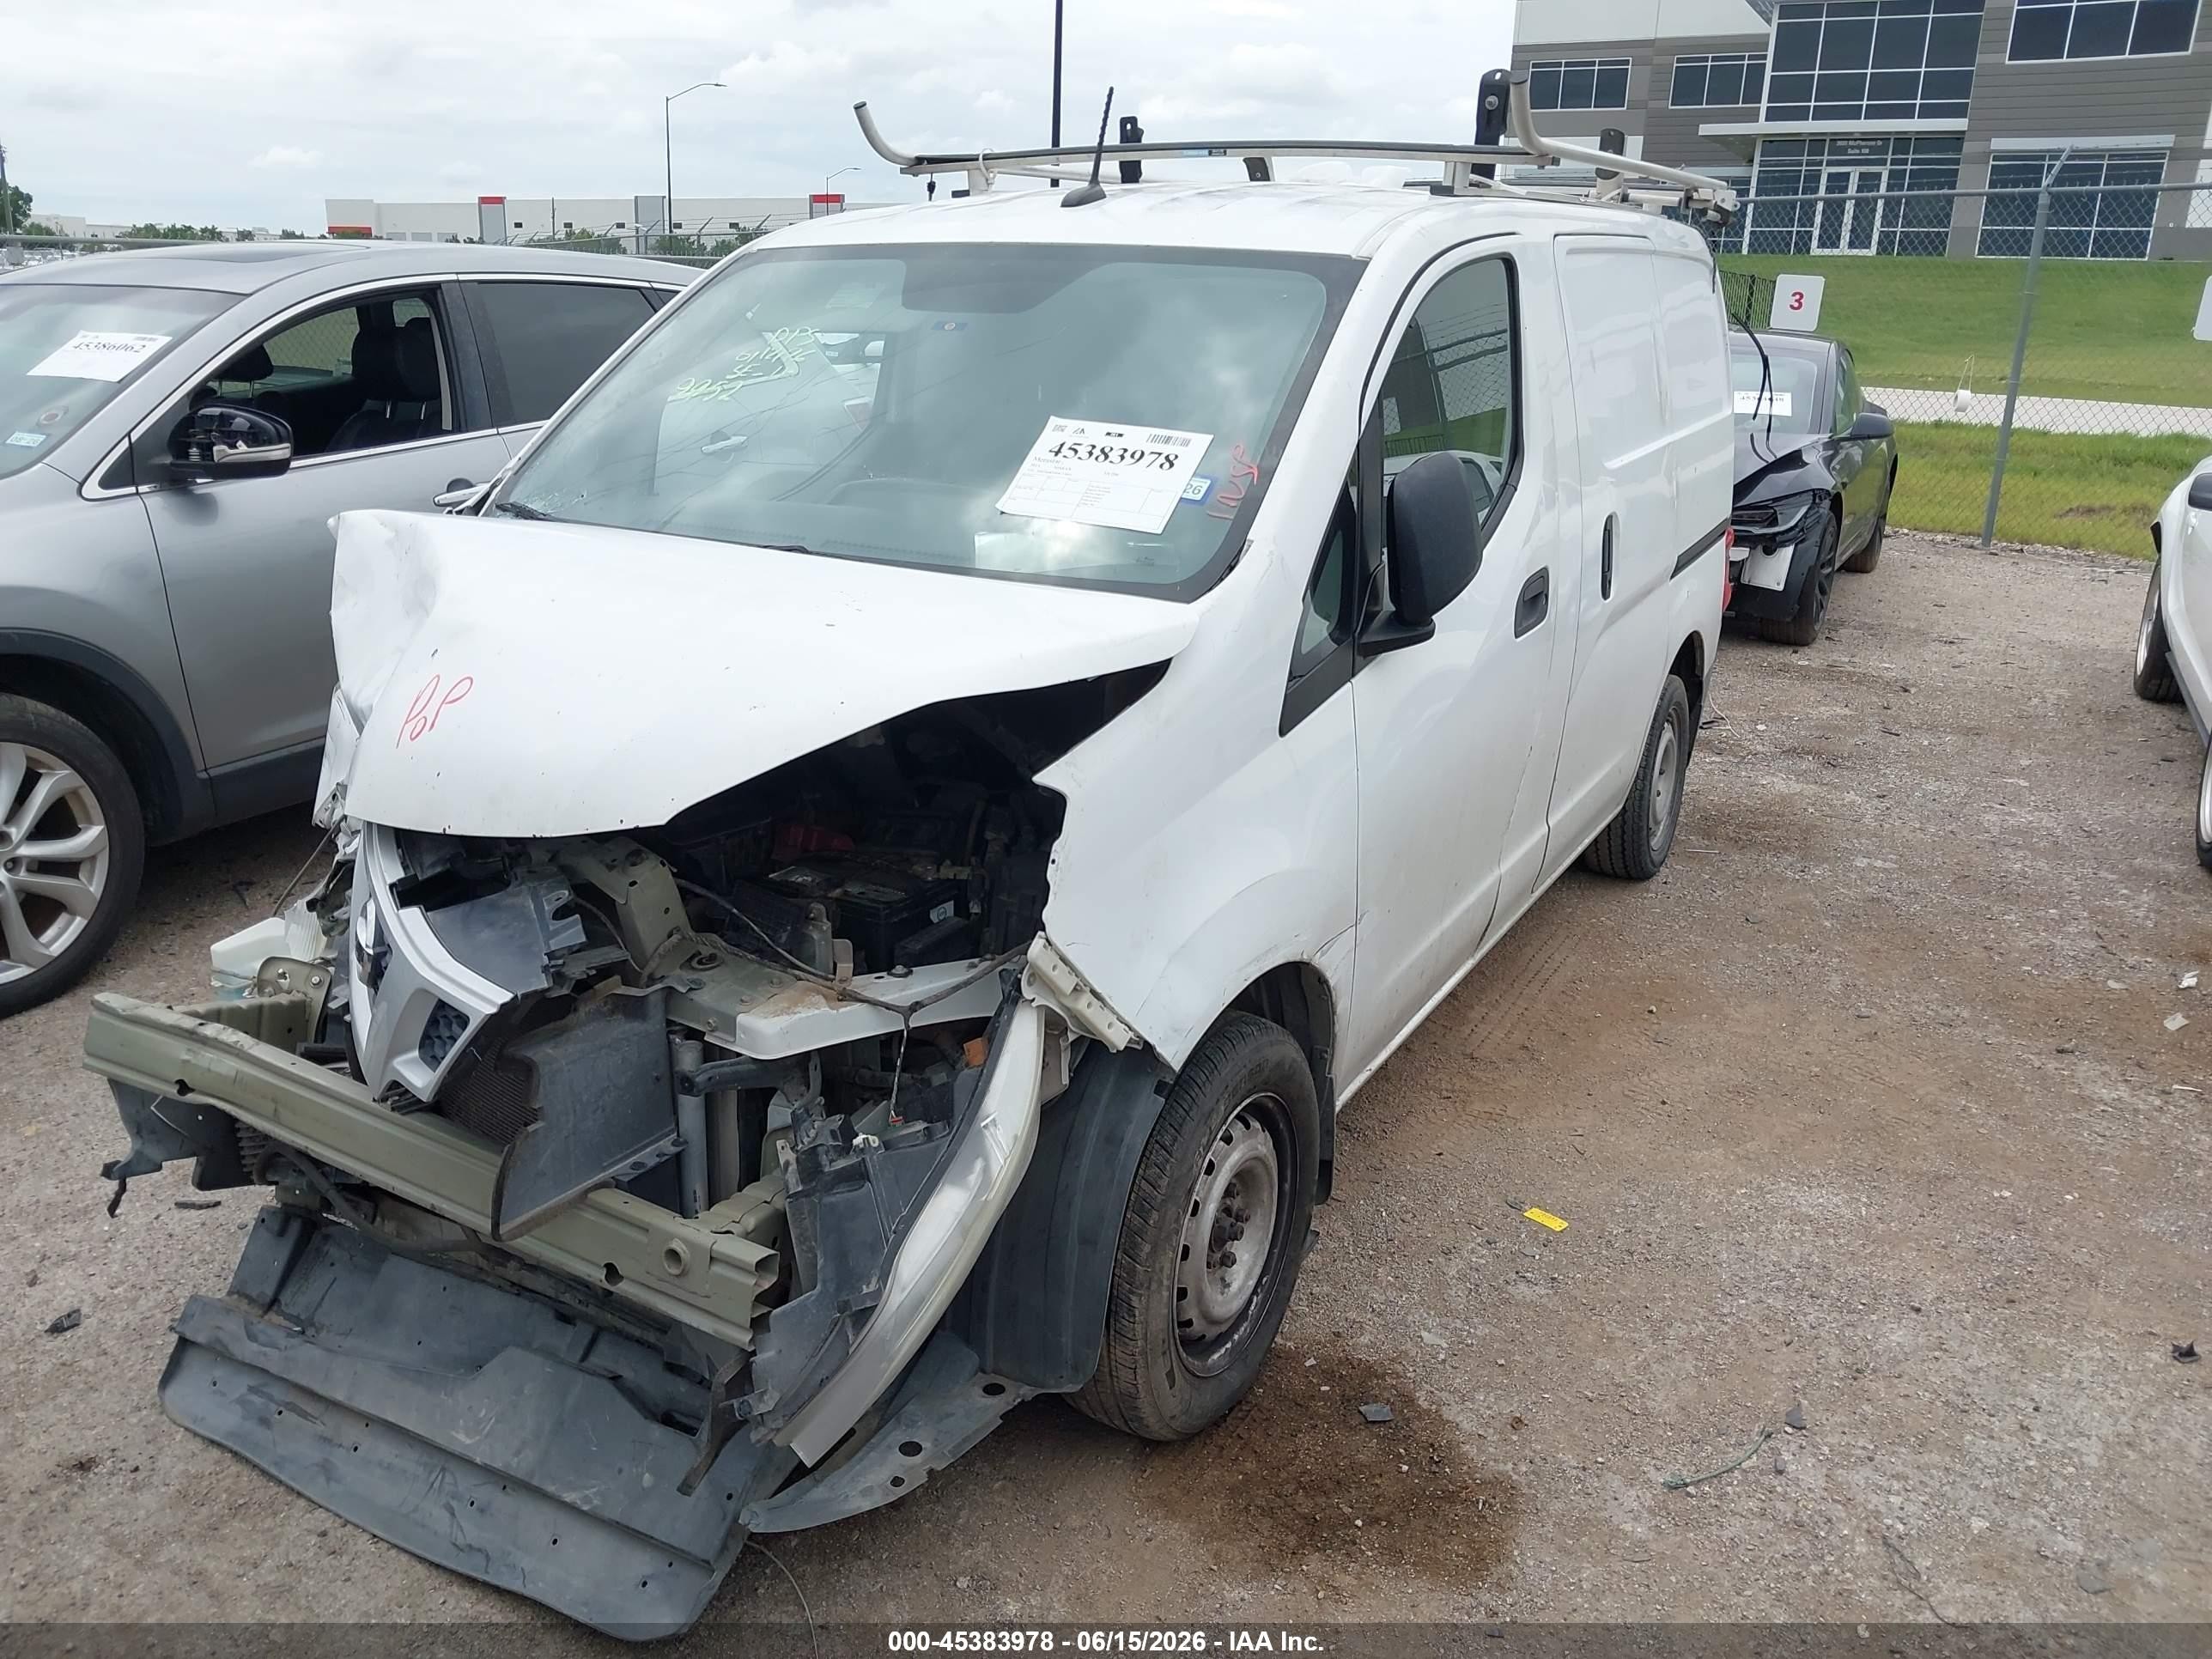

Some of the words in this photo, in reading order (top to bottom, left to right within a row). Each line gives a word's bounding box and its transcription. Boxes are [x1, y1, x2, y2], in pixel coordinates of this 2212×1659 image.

[1789, 291, 1804, 311] 3
[72, 342, 147, 354] 45386062
[1048, 441, 1180, 471] 45383978
